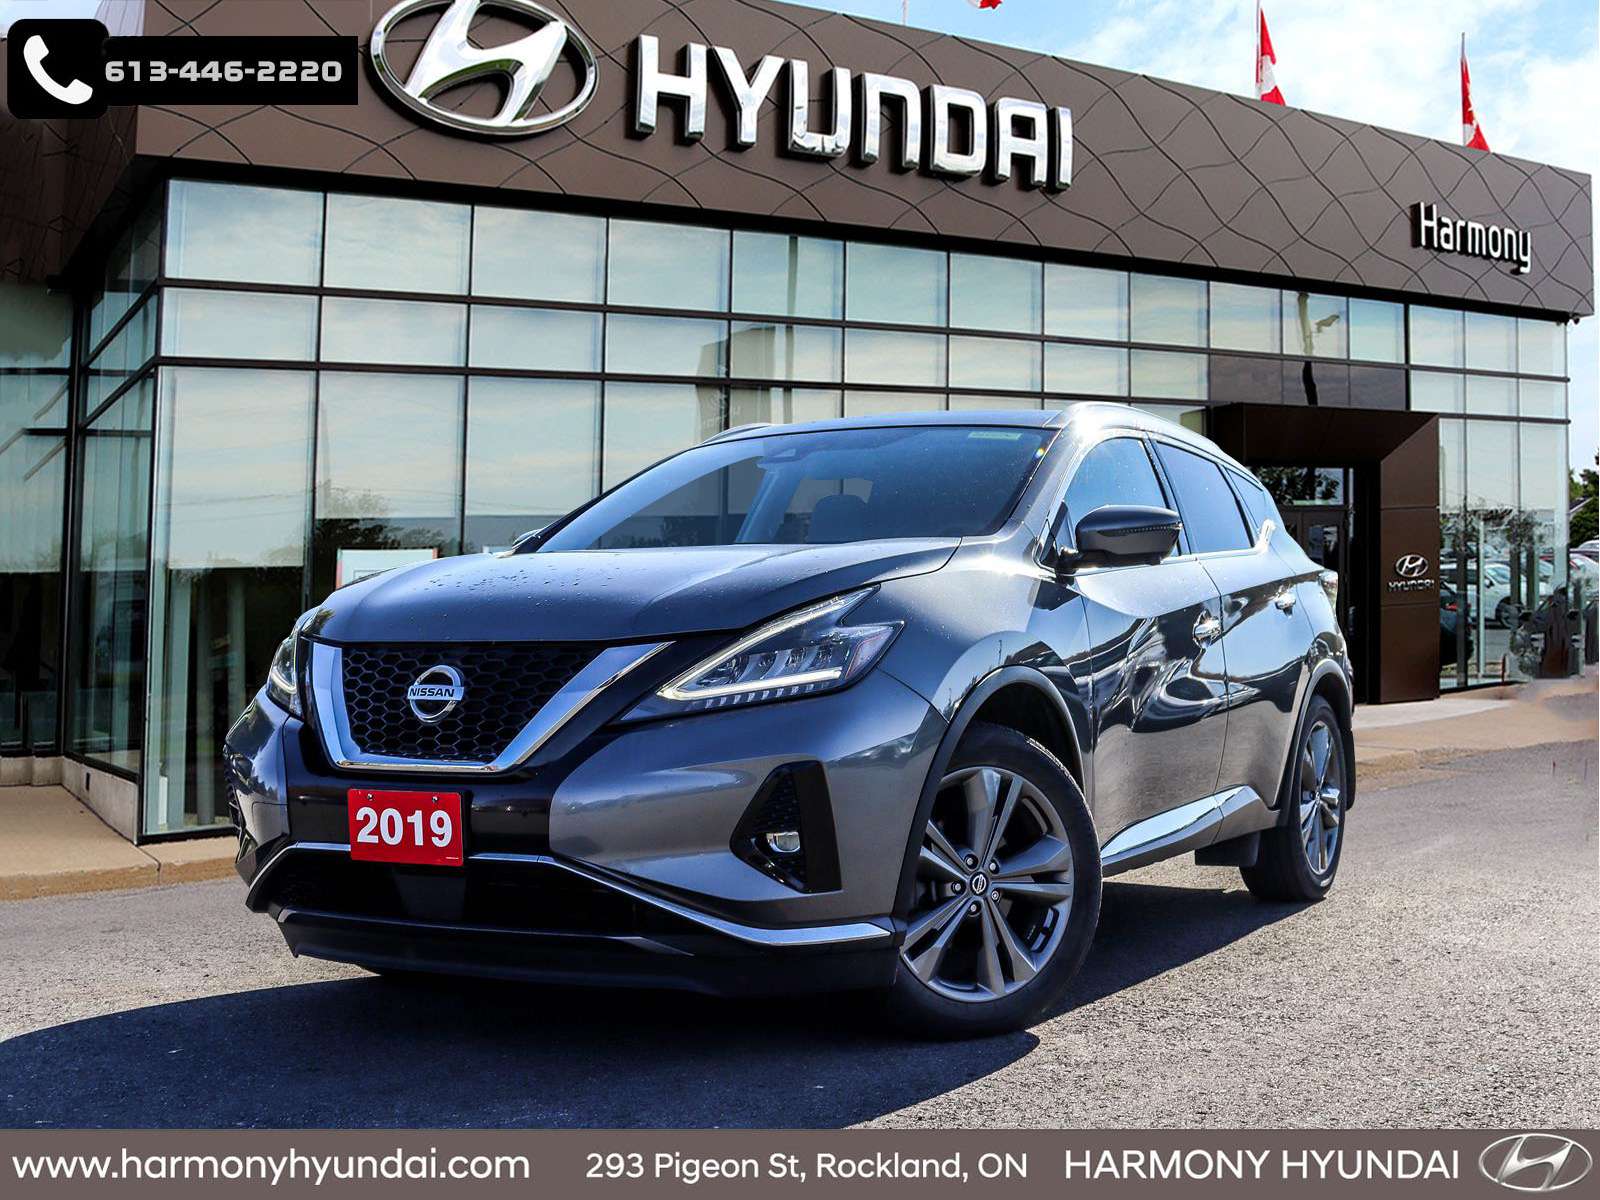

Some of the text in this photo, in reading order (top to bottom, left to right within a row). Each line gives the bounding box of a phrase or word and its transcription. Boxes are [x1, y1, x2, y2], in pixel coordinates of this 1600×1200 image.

[635, 34, 1073, 190] HYUNDAI
[1419, 201, 1532, 273] Harmony
[409, 687, 455, 698] NISSAN
[356, 806, 453, 848] 2019
